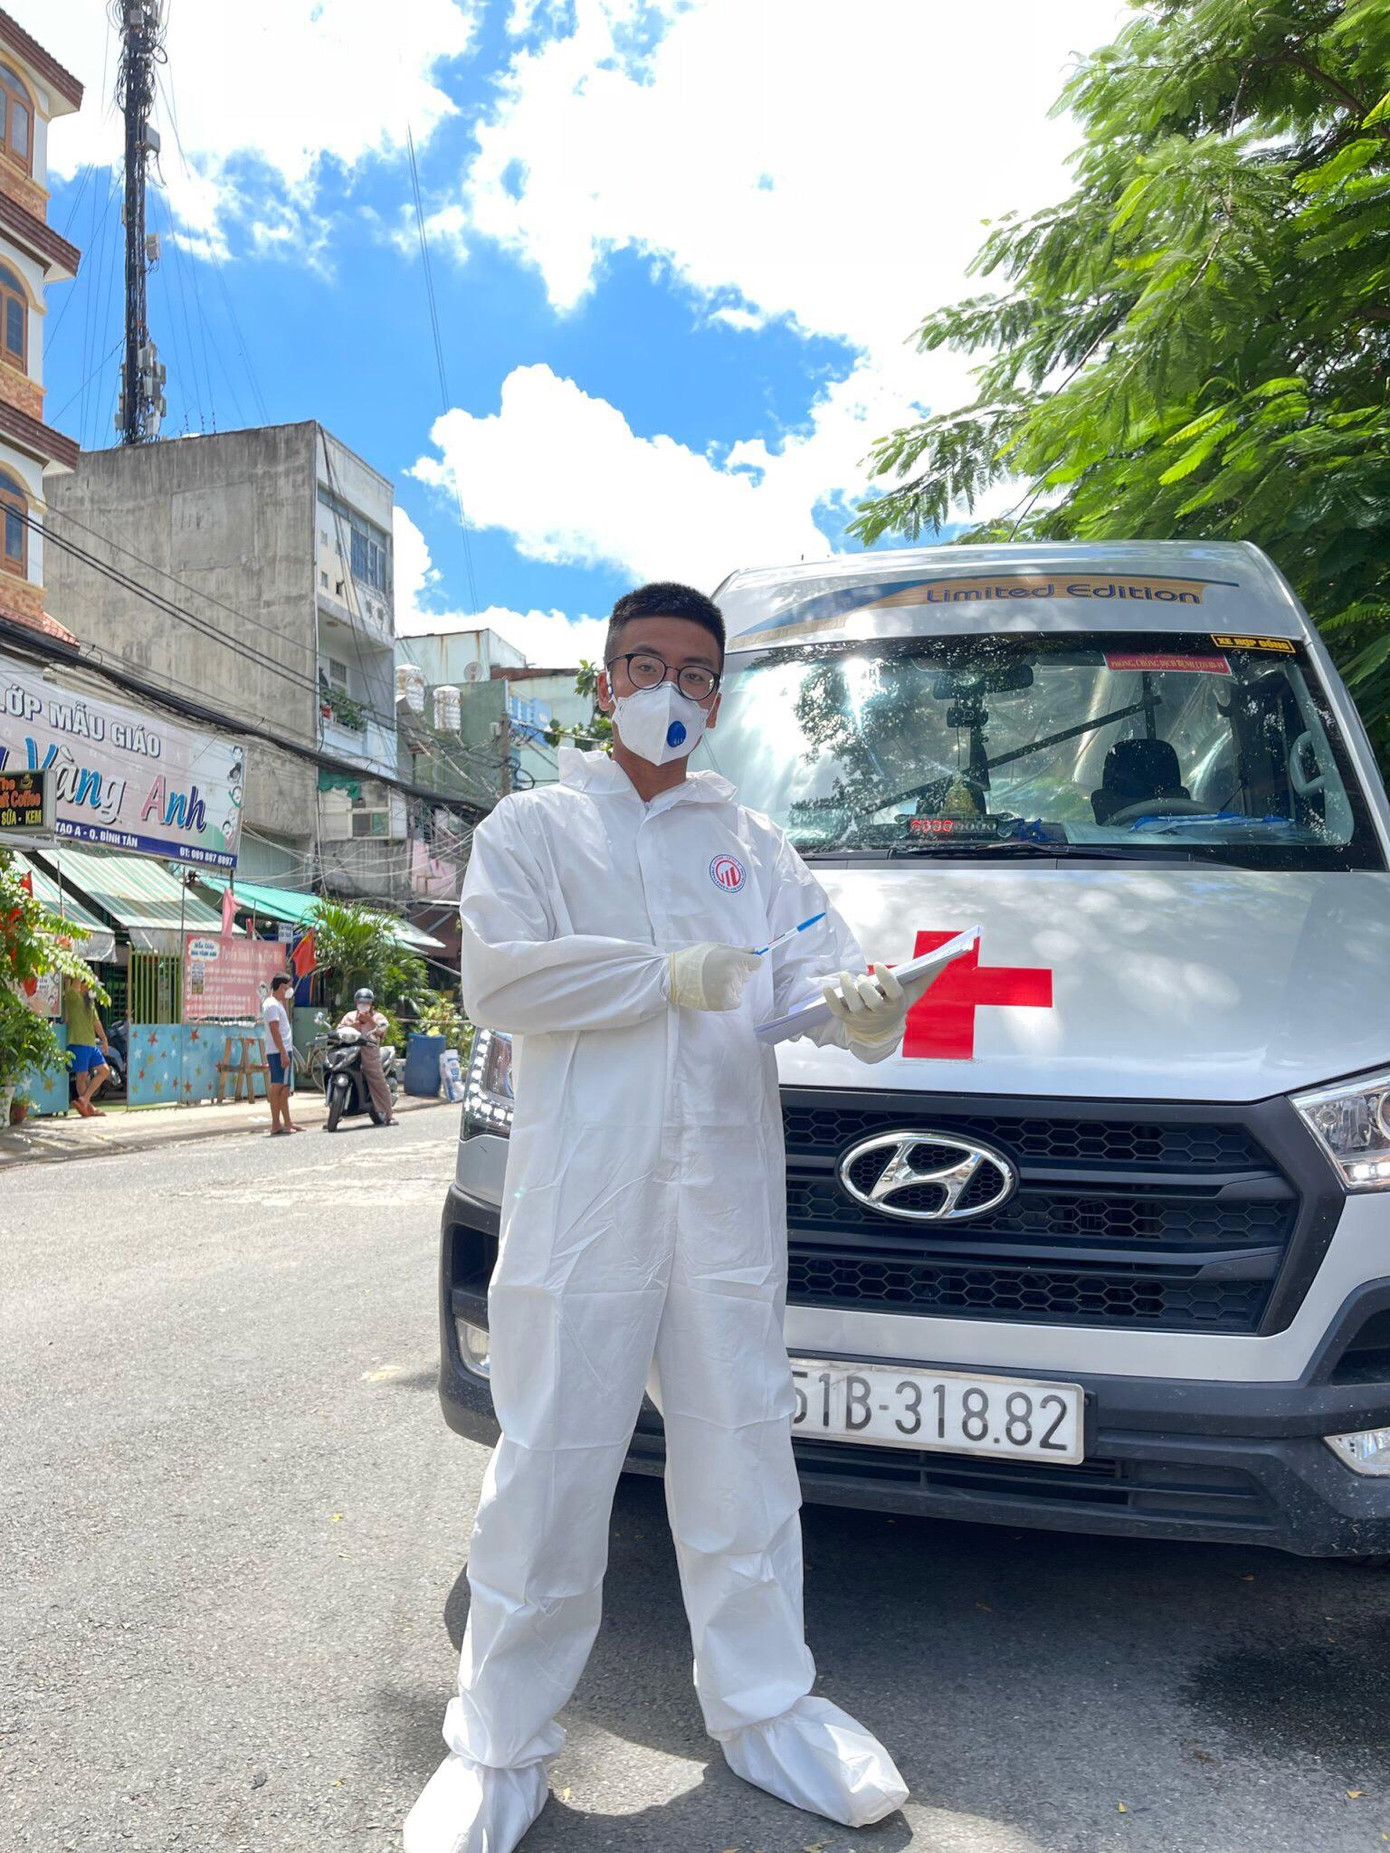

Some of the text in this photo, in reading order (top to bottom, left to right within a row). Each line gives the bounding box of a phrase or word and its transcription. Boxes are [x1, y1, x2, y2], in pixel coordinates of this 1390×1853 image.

[926, 583, 1201, 605] Limited Edition
[1217, 637, 1233, 645] XE
[49, 699, 105, 742] MẪU
[110, 720, 161, 758] GIÁO
[140, 773, 207, 833] Anh
[25, 809, 42, 824] KEM
[74, 825, 81, 836] A
[100, 831, 120, 844] BÌNH
[121, 835, 138, 848] TÂN
[791, 1371, 1068, 1451] 51B-318.82
